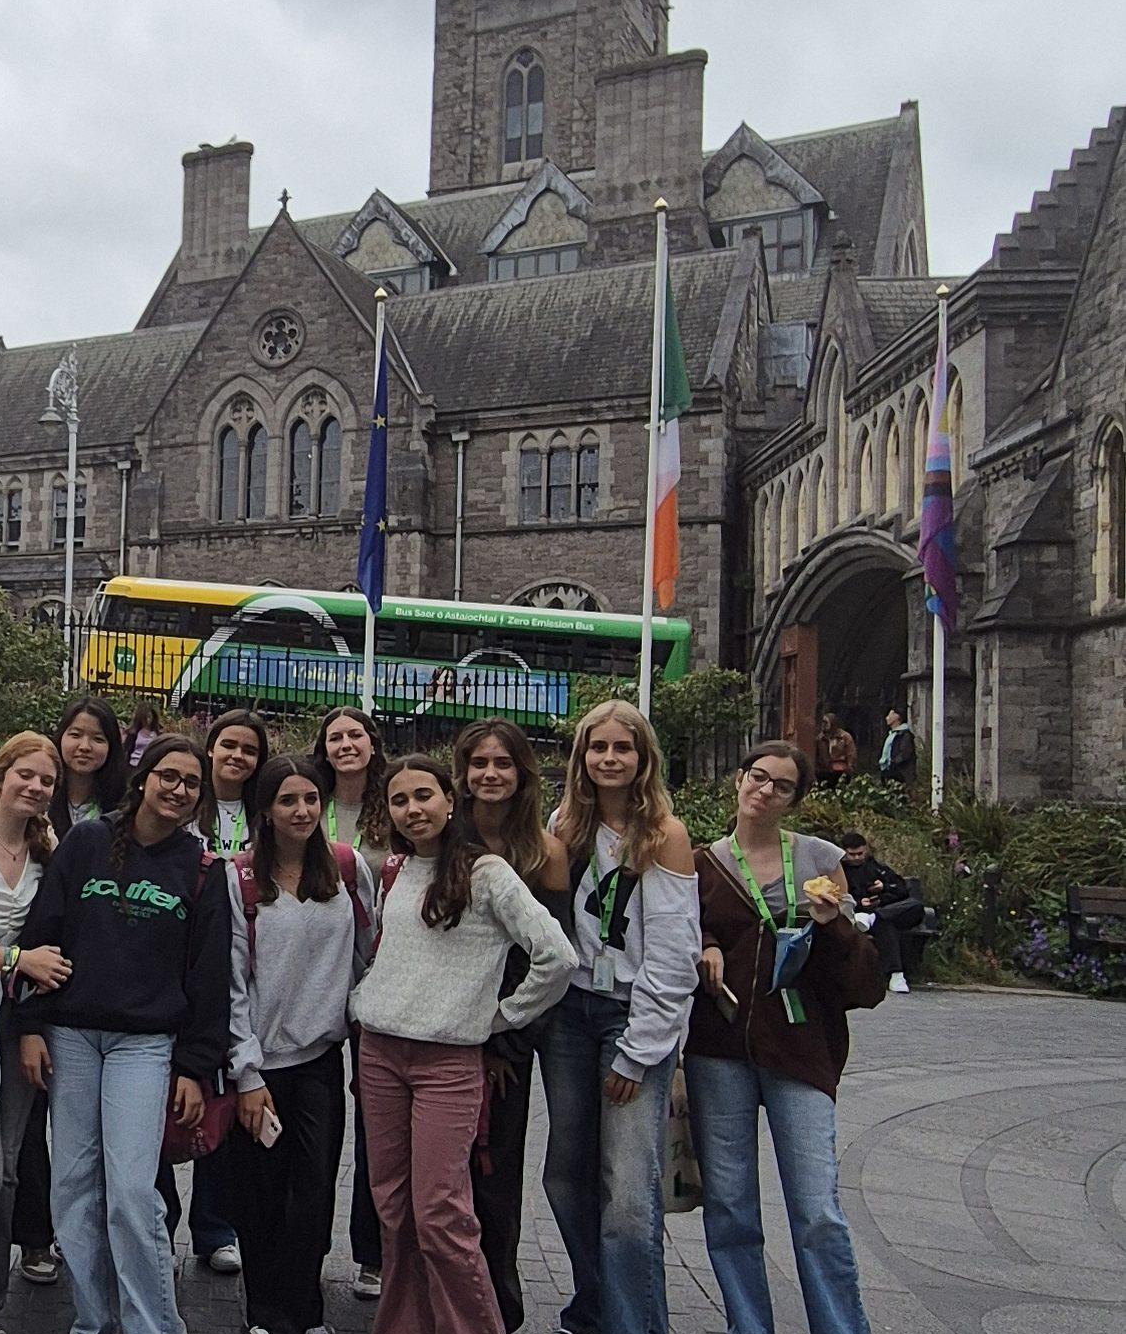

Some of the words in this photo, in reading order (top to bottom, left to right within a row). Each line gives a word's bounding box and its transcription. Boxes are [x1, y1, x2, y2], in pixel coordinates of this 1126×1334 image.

[395, 607, 412, 617] Bus
[507, 616, 530, 626] Zero
[531, 618, 574, 629] Emission
[575, 621, 595, 632] Bus
